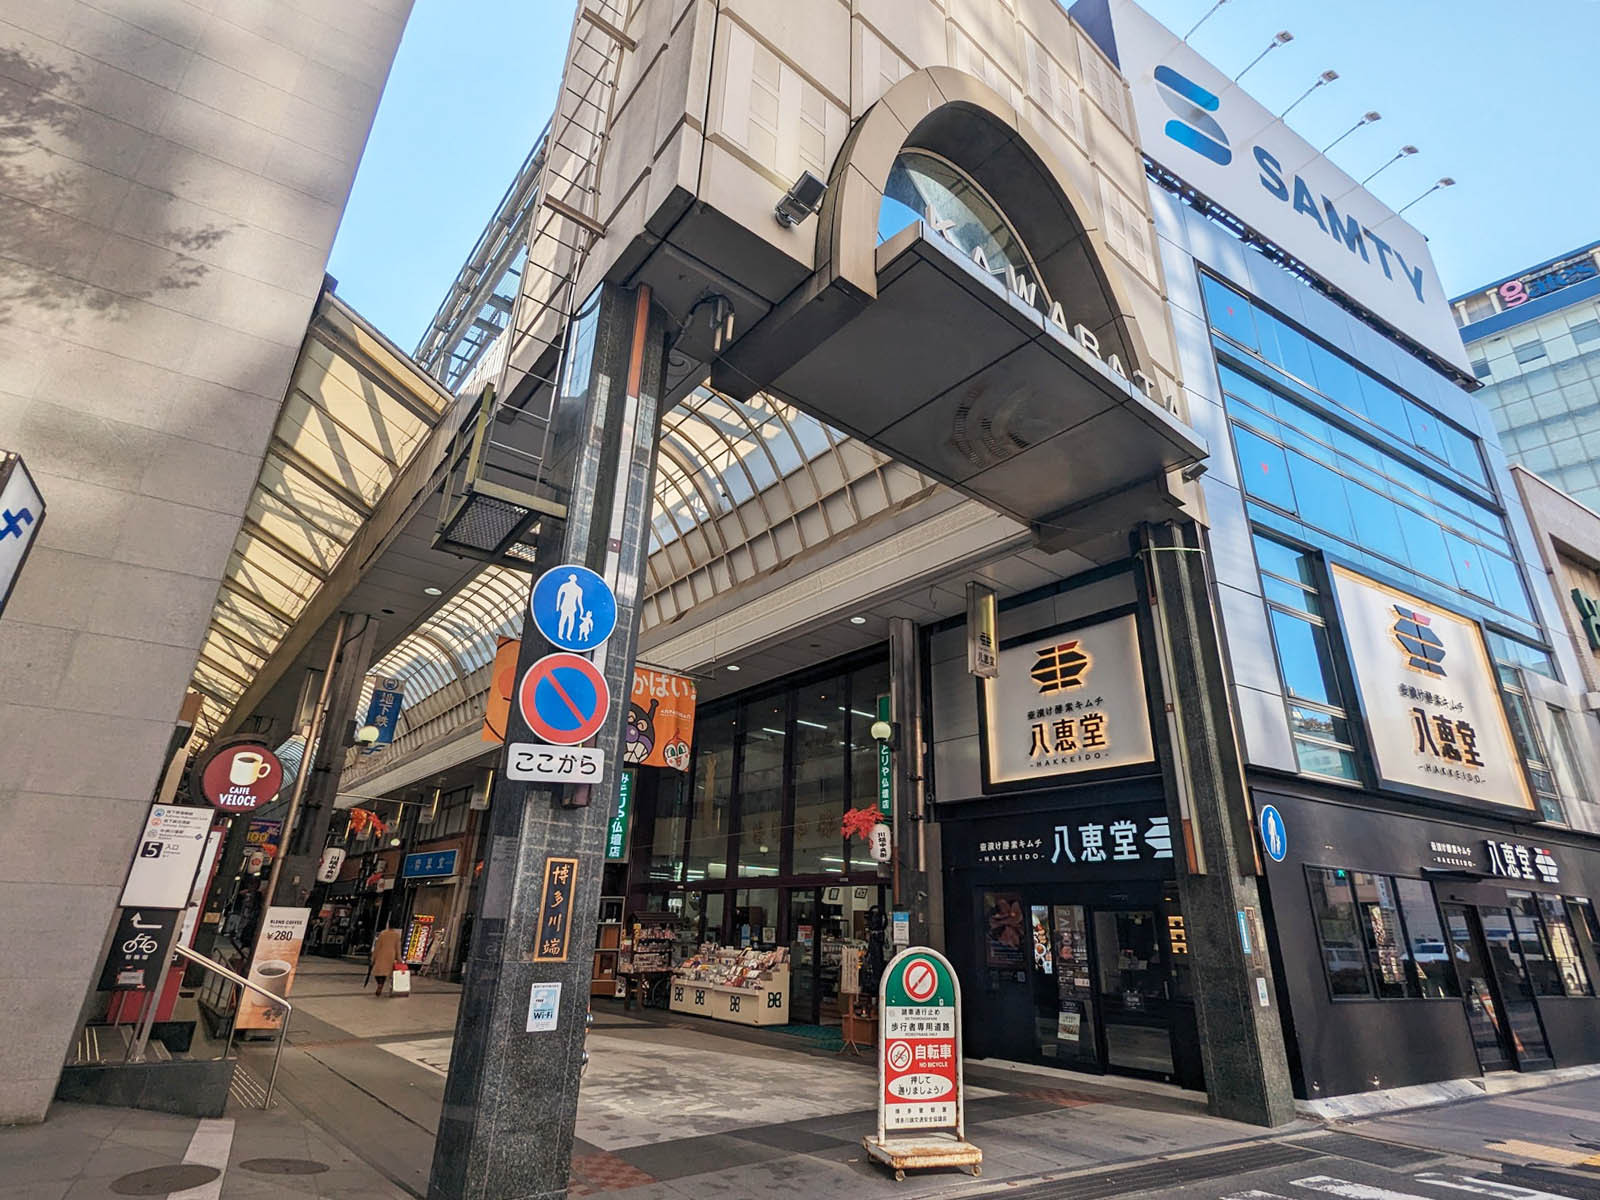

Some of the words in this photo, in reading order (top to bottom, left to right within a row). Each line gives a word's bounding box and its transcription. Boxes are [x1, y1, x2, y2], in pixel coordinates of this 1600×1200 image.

[1253, 145, 1425, 304] SAMTY
[375, 692, 395, 728] 地下鉄
[1029, 713, 1106, 757] 八恵堂
[1412, 707, 1485, 768] 八恵堂
[515, 751, 597, 775] ここから
[219, 794, 257, 807] VELOCE
[229, 787, 250, 795] CAFFE
[145, 842, 159, 857] 5
[1051, 820, 1141, 864] 八恵堂
[1487, 840, 1536, 880] 八恵堂
[542, 864, 571, 956] 博多川端
[891, 1022, 950, 1032] 歩行者専用道路
[915, 1043, 952, 1060] 自転車
[911, 1076, 931, 1085] 押して
